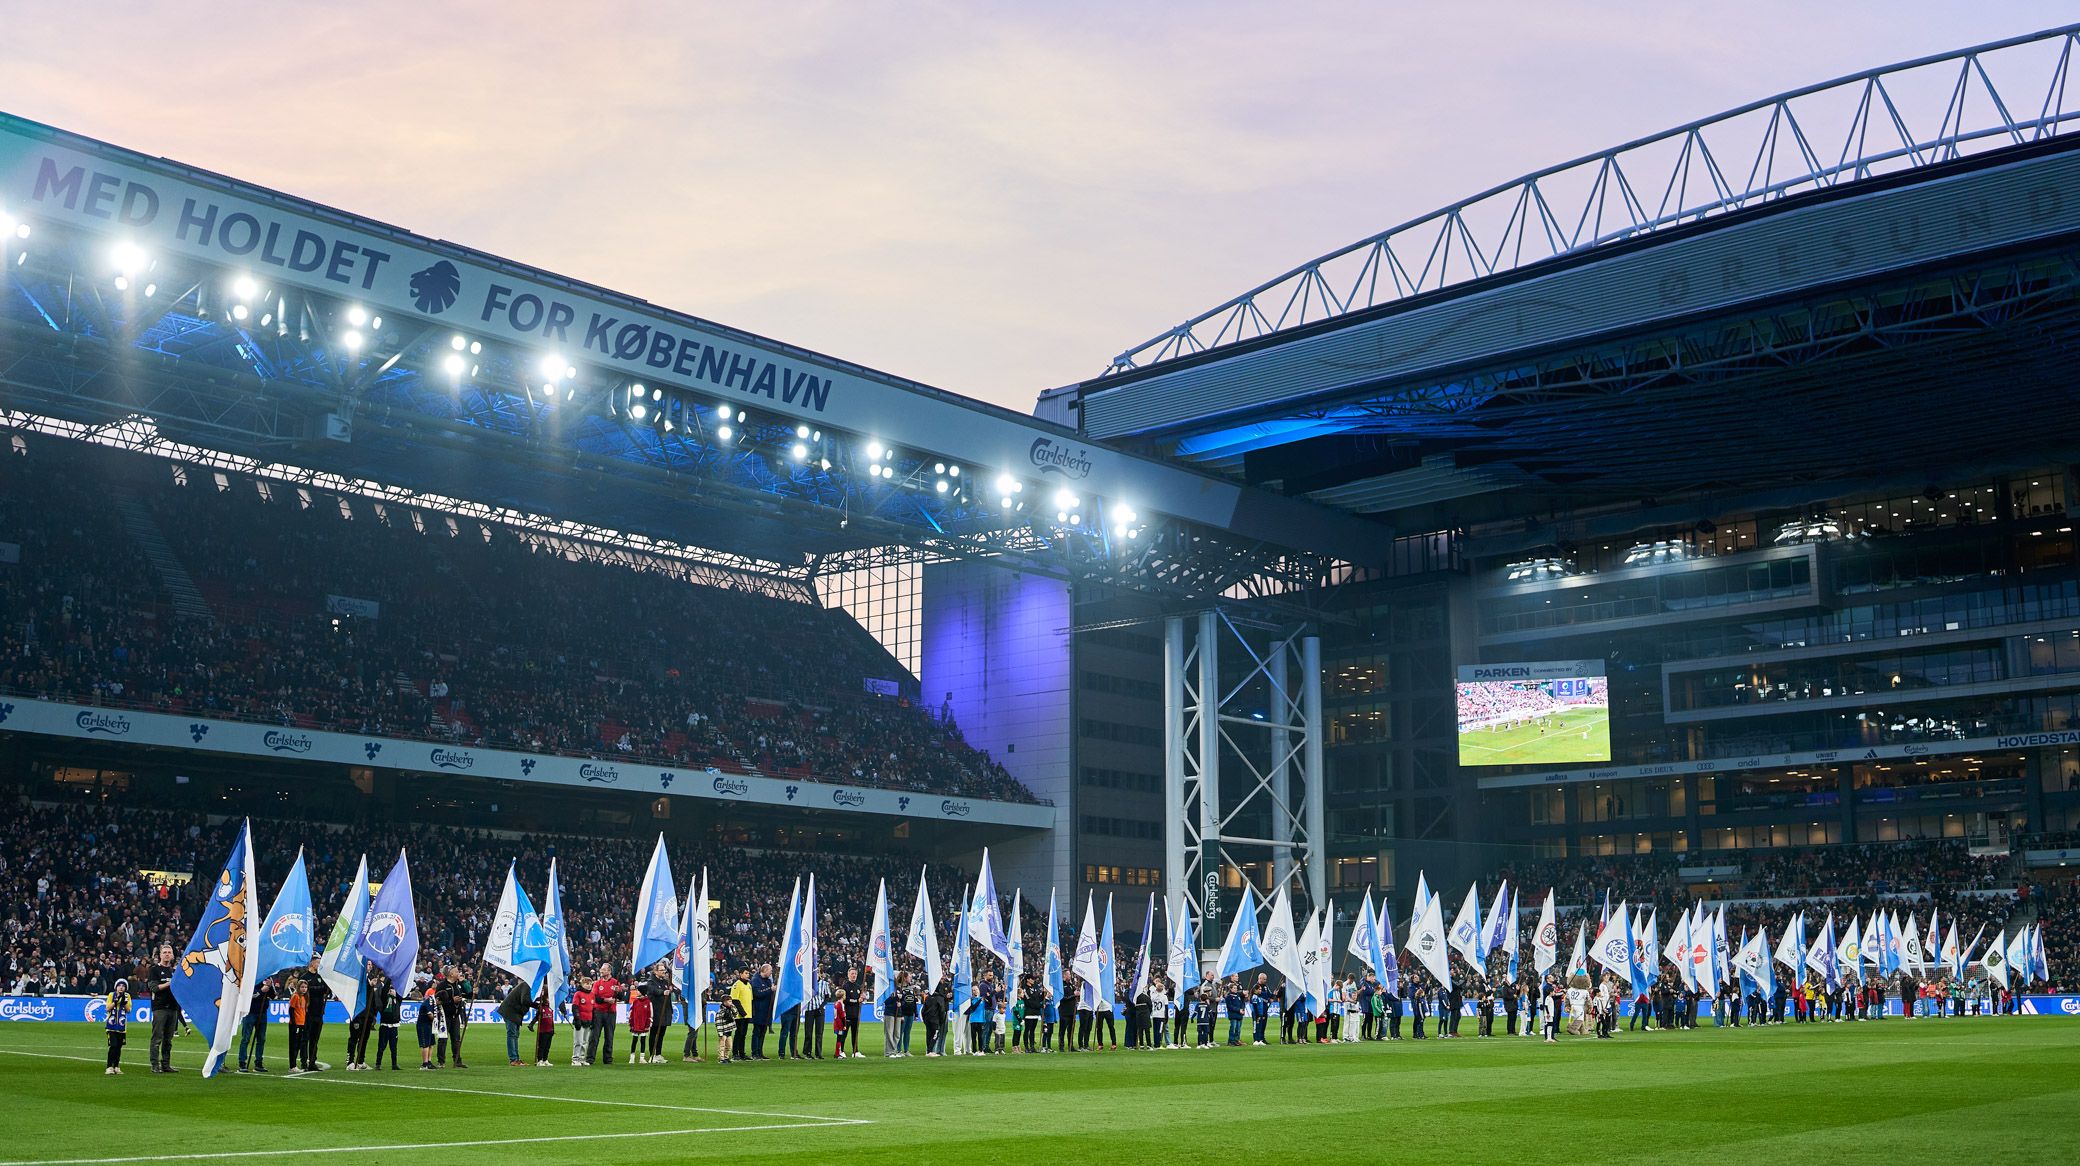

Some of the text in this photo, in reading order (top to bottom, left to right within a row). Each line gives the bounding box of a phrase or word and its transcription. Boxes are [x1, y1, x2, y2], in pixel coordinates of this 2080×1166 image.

[31, 157, 390, 291] MED HOLDET
[480, 283, 832, 412] FOR KØBENHAVN
[1029, 437, 1092, 480] Carlsberg
[1474, 667, 1530, 678] PARKEN
[76, 710, 131, 735] Carlsberg
[263, 730, 313, 753] Carlsberg
[1997, 730, 2080, 748] HOVEDSTA
[430, 749, 474, 769] Carlsberg
[1737, 758, 1760, 767] andel
[580, 763, 619, 783] Carlsberg
[713, 777, 748, 795] Carlsberg
[833, 789, 865, 807] Carlsberg
[941, 800, 970, 816] Carlsberg
[1204, 871, 1221, 920] Carlsberg
[0, 999, 55, 1021] Carlsberg
[1200, 1006, 1207, 1019] 7
